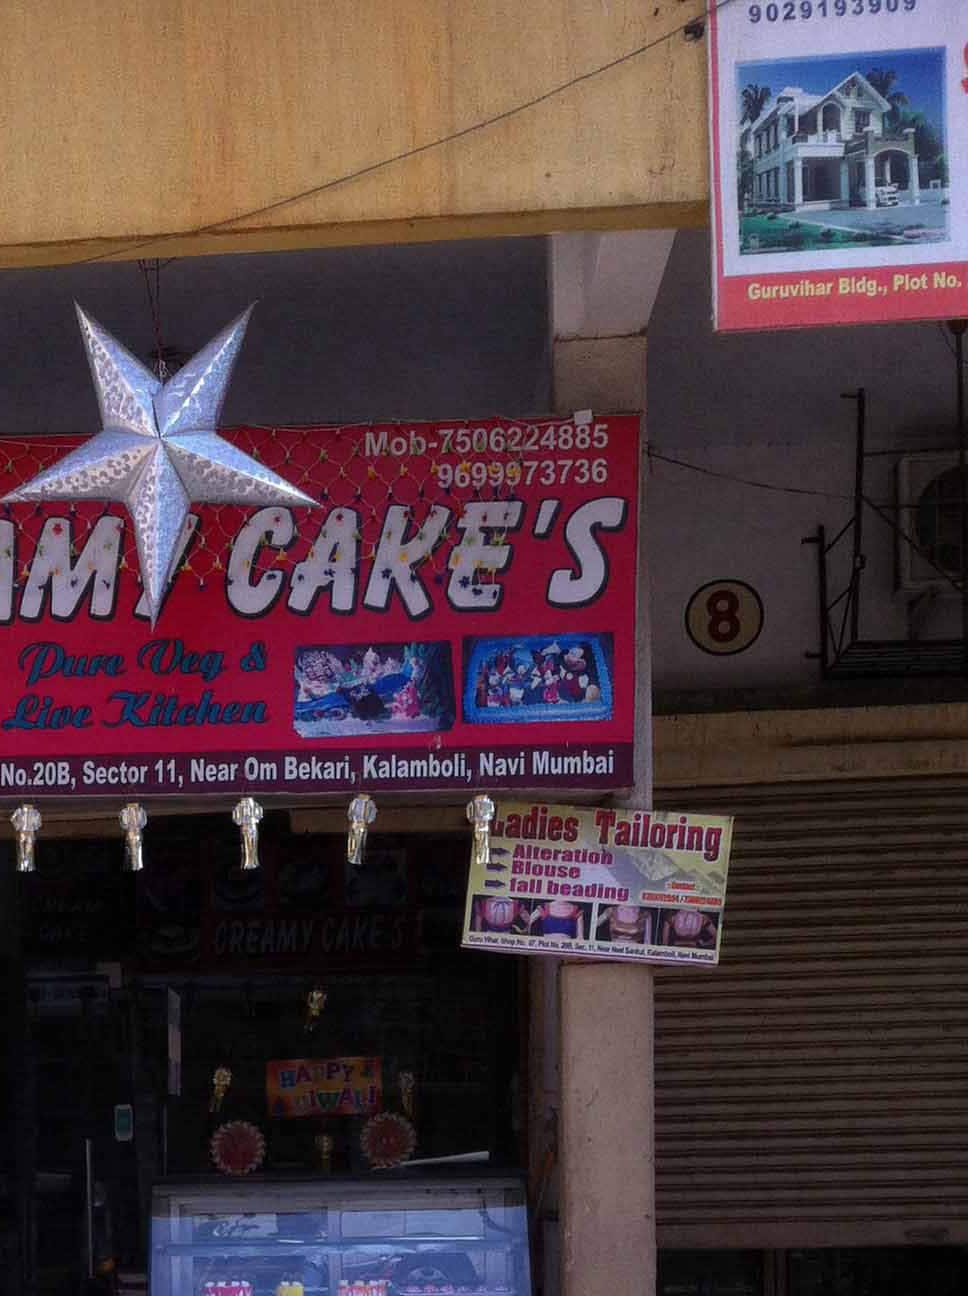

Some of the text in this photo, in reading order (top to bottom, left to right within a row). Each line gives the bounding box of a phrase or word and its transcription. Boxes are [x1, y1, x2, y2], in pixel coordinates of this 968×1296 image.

[748, 0, 916, 23] 9029193909
[748, 271, 962, 301] Guruvihar Bldg., Plot No.
[437, 458, 609, 489] 9699973736
[226, 496, 627, 620] CAKE'S
[706, 590, 740, 642] 8
[17, 639, 269, 687] Pure Veg &
[1, 689, 270, 731] Live Kitchen
[0, 760, 76, 790] No.20B,
[82, 759, 148, 786] Sector
[154, 758, 183, 788] 11,
[190, 758, 239, 783] Near
[244, 756, 277, 781] Om
[283, 754, 356, 785] Bekari,
[363, 753, 473, 784] Kalamboli,
[479, 751, 526, 777] Navi
[532, 749, 614, 776] Mumbai
[596, 807, 723, 862] Tailoring
[512, 860, 581, 879] Blouse
[513, 844, 613, 865] Alteration
[547, 880, 630, 902] beading
